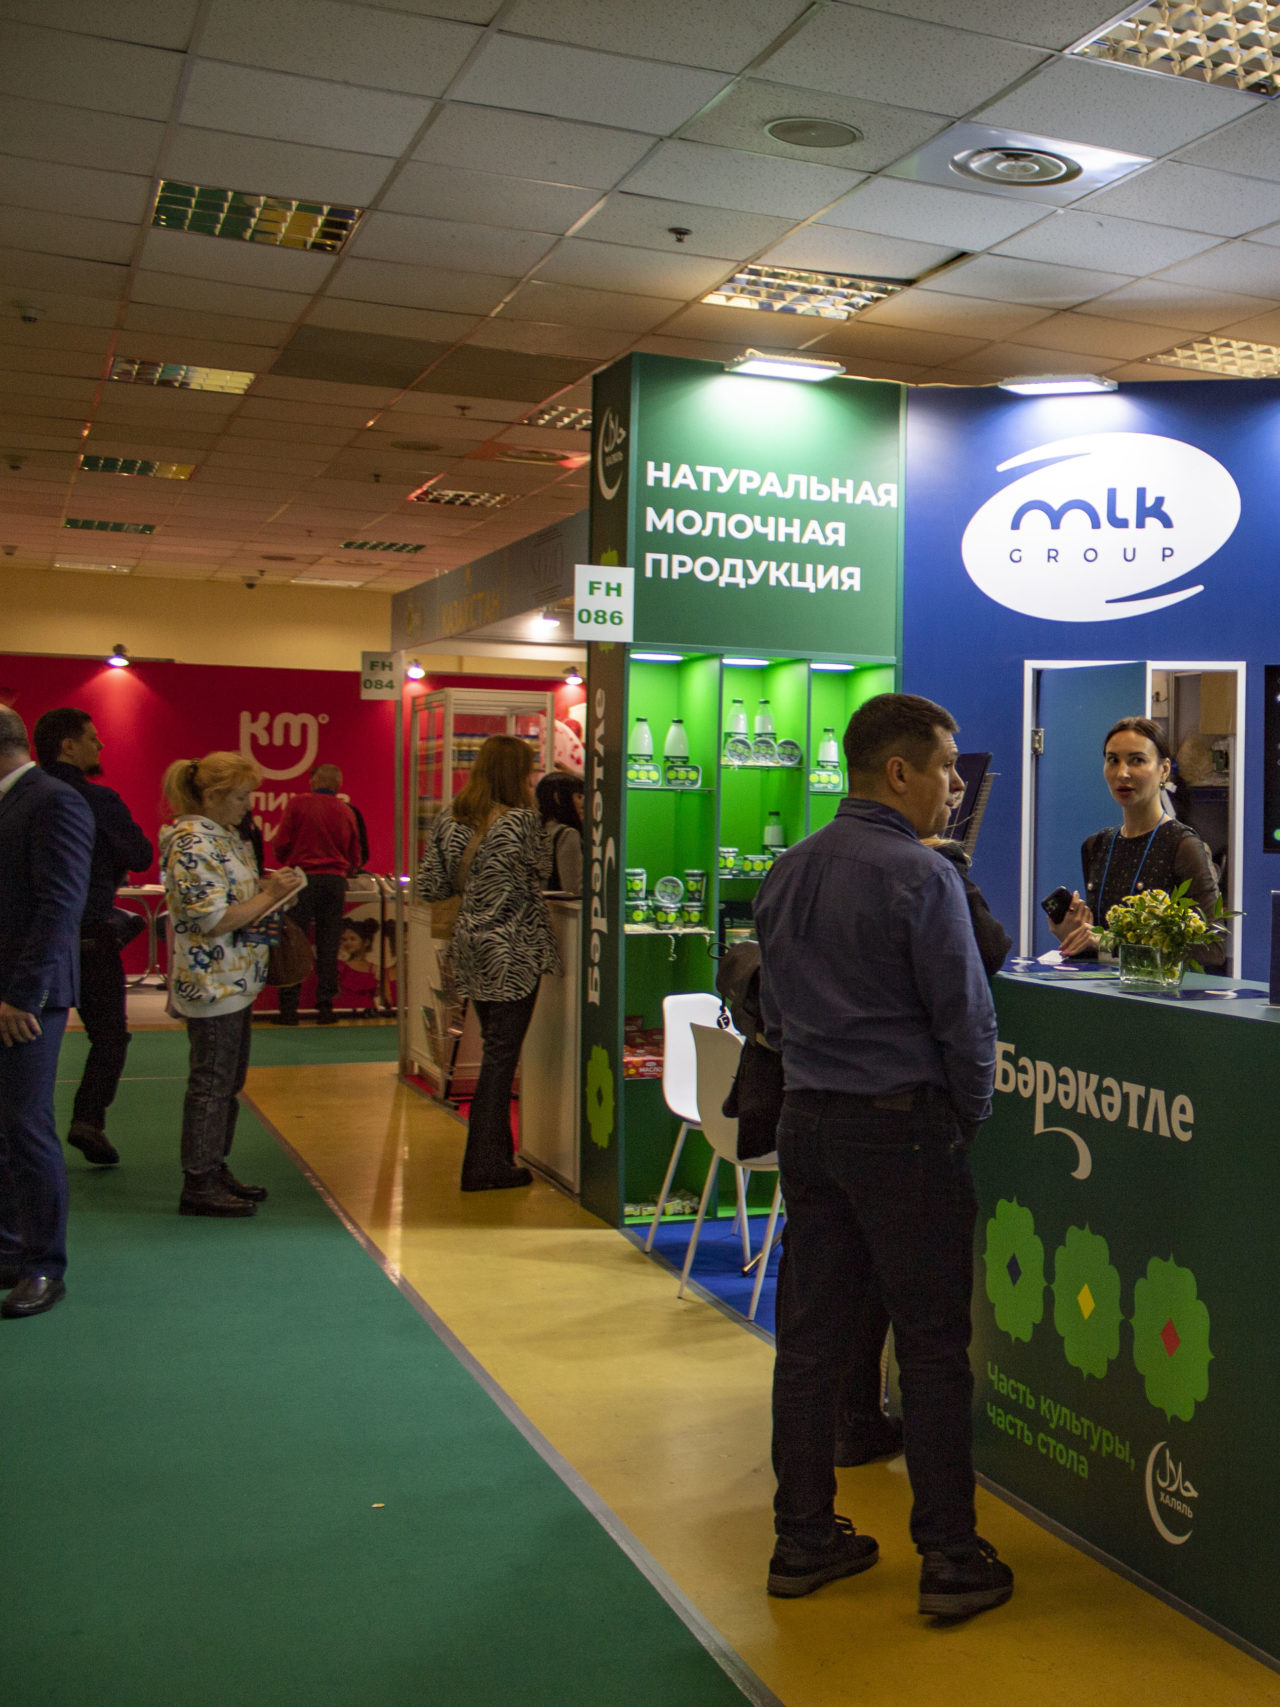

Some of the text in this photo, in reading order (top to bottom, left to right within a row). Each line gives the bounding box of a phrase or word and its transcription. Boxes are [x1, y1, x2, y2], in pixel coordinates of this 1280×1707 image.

[646, 461, 898, 508] НАТУРАЛЬНАЯ
[1010, 486, 1174, 531] mlk
[645, 506, 846, 547] МОЛОЧНАЯ
[1009, 546, 1175, 564] GROUP
[588, 580, 622, 597] FH
[644, 552, 861, 593] ПРОДУКЦИЯ
[577, 608, 623, 626] 086
[369, 660, 393, 671] FH
[363, 679, 395, 690] 084
[986, 1401, 1089, 1479] часть стола
[1040, 1395, 1135, 1472] культуры,
[1160, 1491, 1194, 1519] ХАЛЯЛЬ
